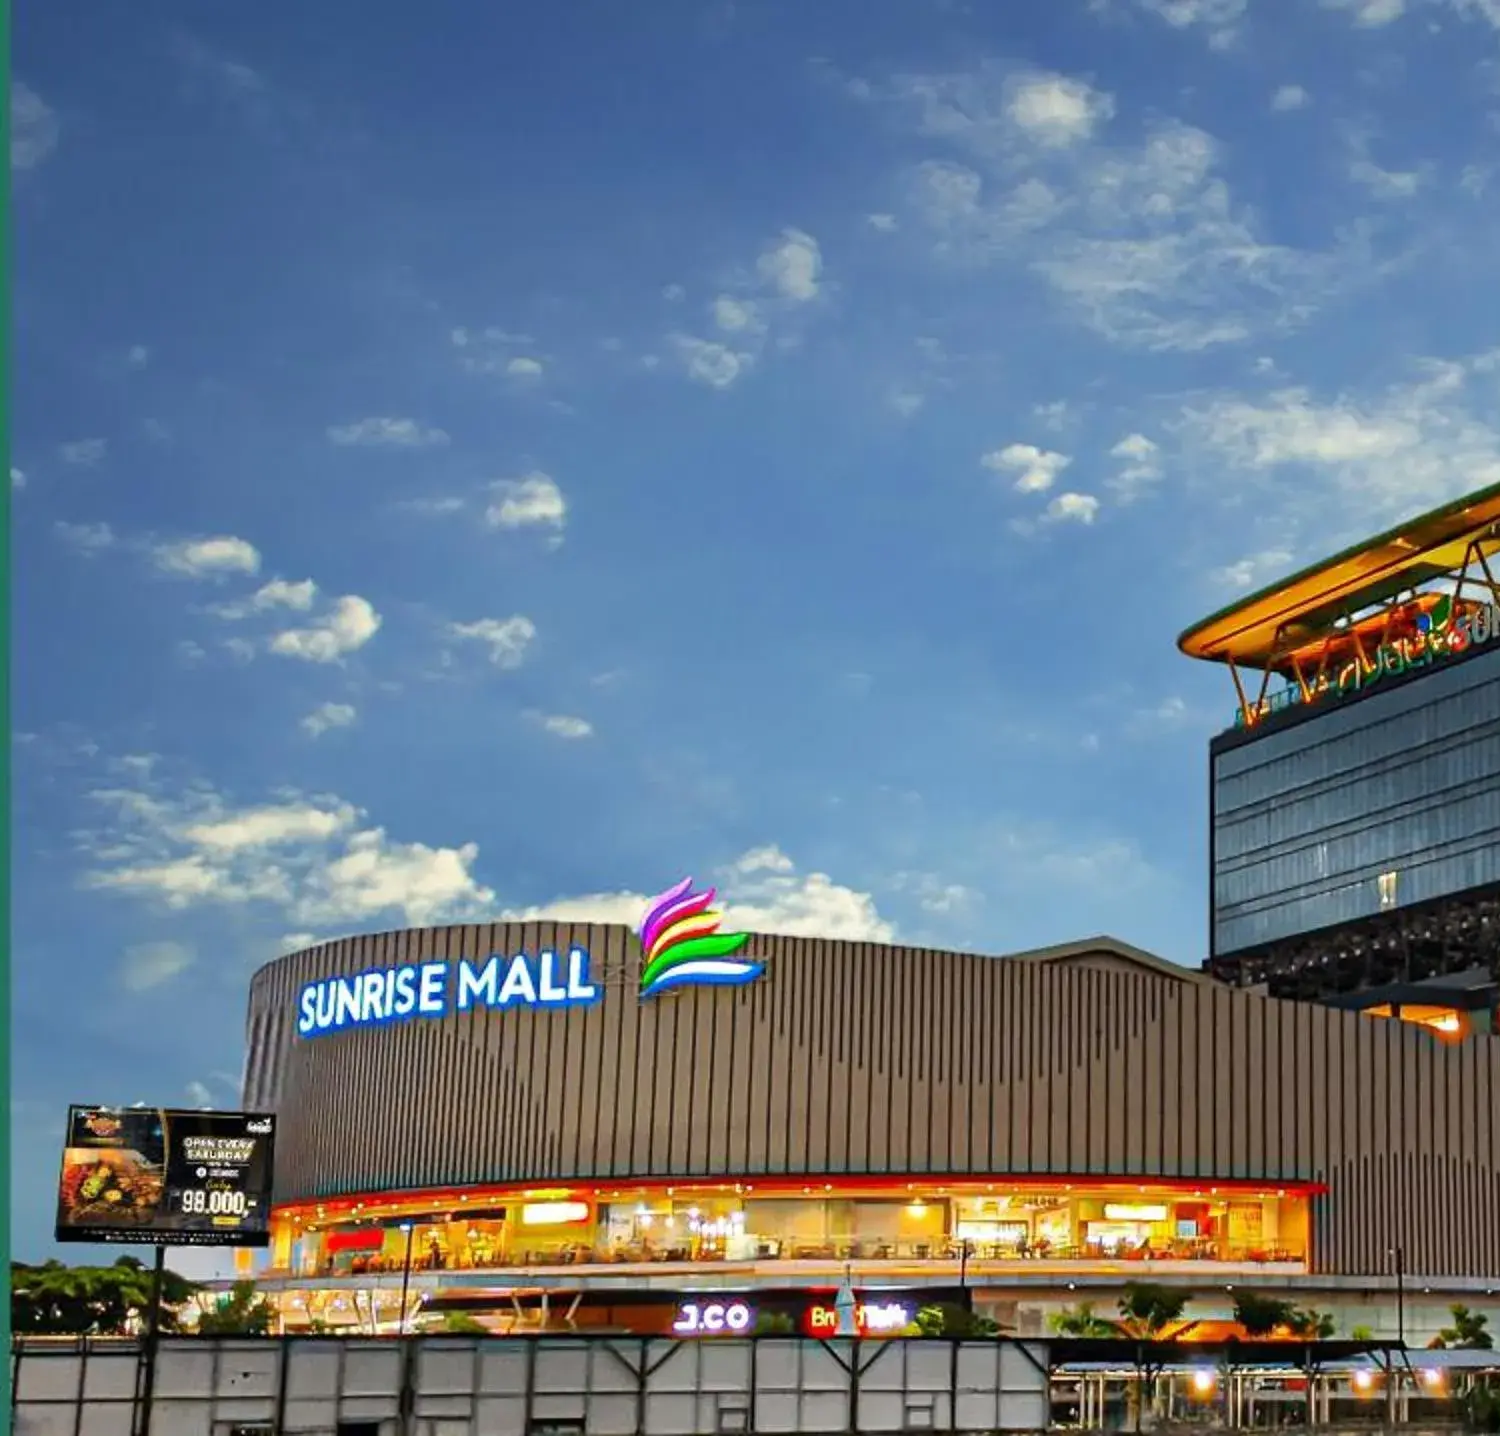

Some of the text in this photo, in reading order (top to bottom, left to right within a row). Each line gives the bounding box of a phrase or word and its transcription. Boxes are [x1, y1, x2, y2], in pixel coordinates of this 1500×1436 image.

[298, 948, 596, 1033] SUNRISE MALL
[184, 1137, 215, 1148] OPEN
[673, 1304, 749, 1329] J.CO
